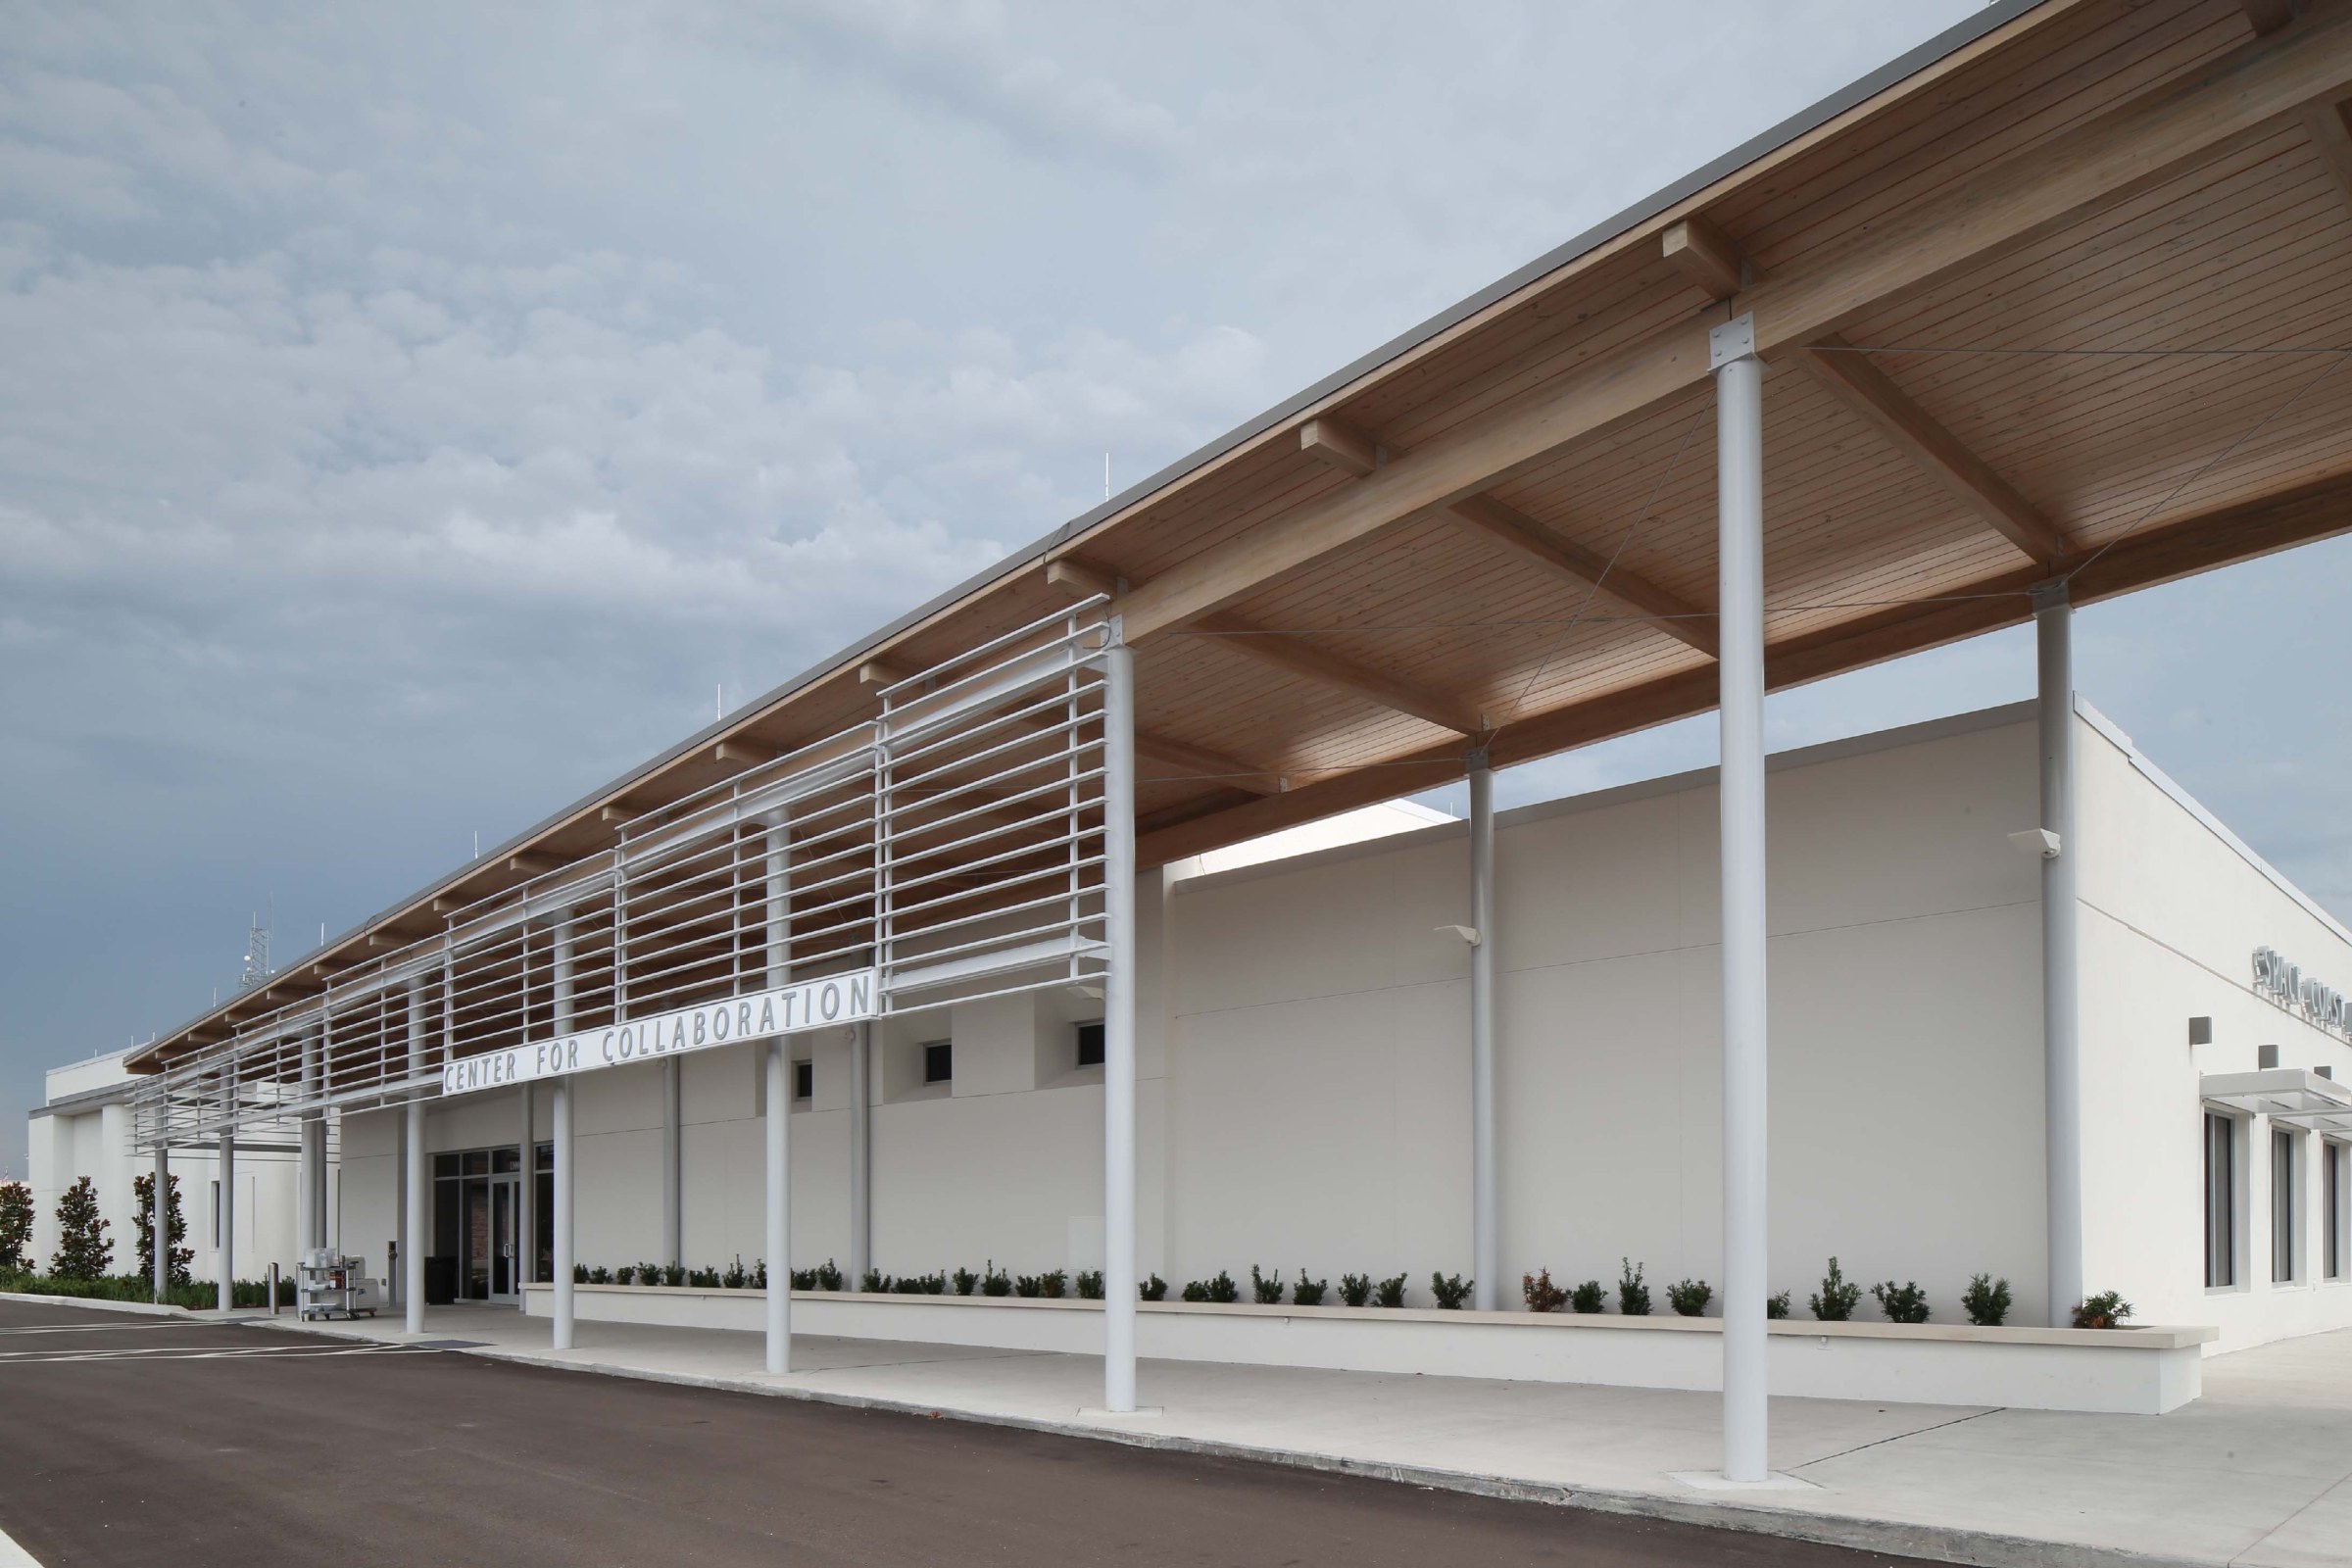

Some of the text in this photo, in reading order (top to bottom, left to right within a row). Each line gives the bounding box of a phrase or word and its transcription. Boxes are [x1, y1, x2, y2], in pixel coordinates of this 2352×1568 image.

[445, 976, 869, 1092] CENTER FOR COLLABORATION
